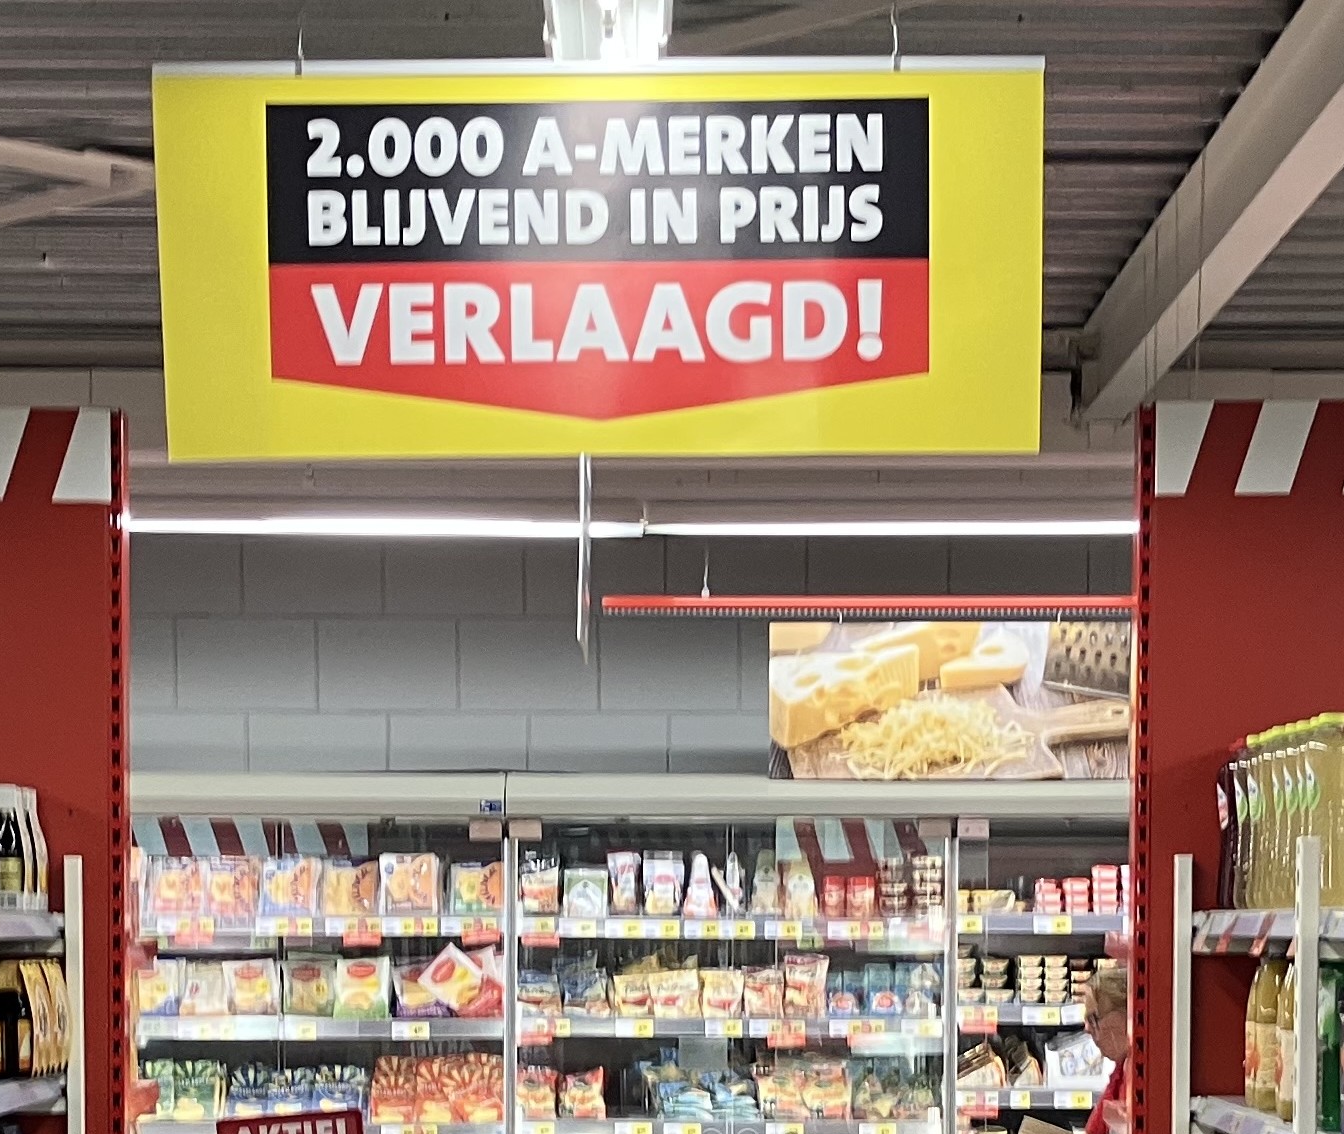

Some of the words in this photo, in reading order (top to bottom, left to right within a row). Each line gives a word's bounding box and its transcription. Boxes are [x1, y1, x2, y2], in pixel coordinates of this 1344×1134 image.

[306, 117, 504, 179] 2.000
[522, 112, 884, 178] A-MERKEN
[306, 186, 610, 247] BLIJVEND
[629, 186, 698, 245] IN
[718, 183, 884, 244] PRIJS
[309, 277, 885, 368] VERLAAGD!
